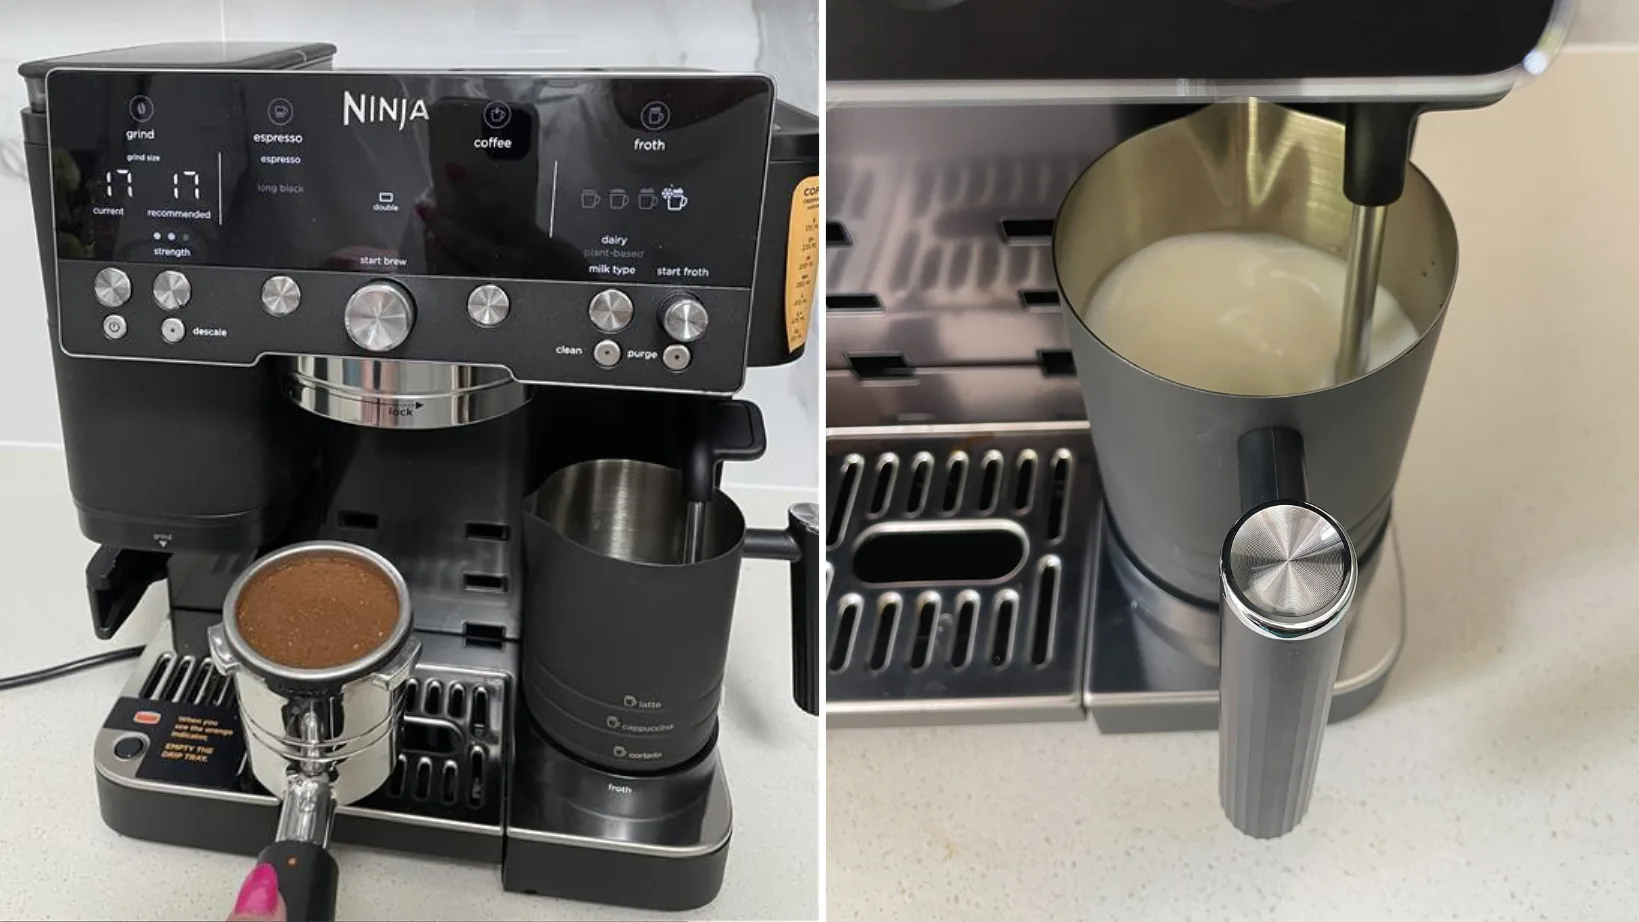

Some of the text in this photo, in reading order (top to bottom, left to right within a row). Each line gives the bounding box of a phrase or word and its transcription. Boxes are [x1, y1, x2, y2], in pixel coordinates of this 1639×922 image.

[343, 90, 430, 130] NINJA
[126, 129, 155, 140] grind
[253, 133, 303, 144] espresso
[473, 137, 512, 149] coffee
[634, 138, 666, 151] froth
[126, 154, 145, 162] grind
[260, 155, 301, 164] espresso
[257, 184, 304, 194] long black
[93, 207, 124, 216] current
[373, 203, 399, 212] double
[147, 209, 211, 219] recommended
[601, 234, 628, 246] dairy
[153, 247, 192, 257] strength
[584, 249, 645, 259] plant-based
[360, 256, 408, 266] start brew
[589, 264, 636, 276] milk type
[657, 267, 709, 277] start froth
[192, 326, 228, 337] descale
[556, 345, 583, 355] clean
[627, 349, 658, 360] purge
[389, 406, 413, 417] lock
[639, 701, 662, 709] latte
[178, 715, 218, 727] When you
[204, 727, 234, 737] orange
[165, 742, 214, 755] EMPTY THE
[161, 750, 183, 759] DRIP
[608, 783, 633, 794] froth
